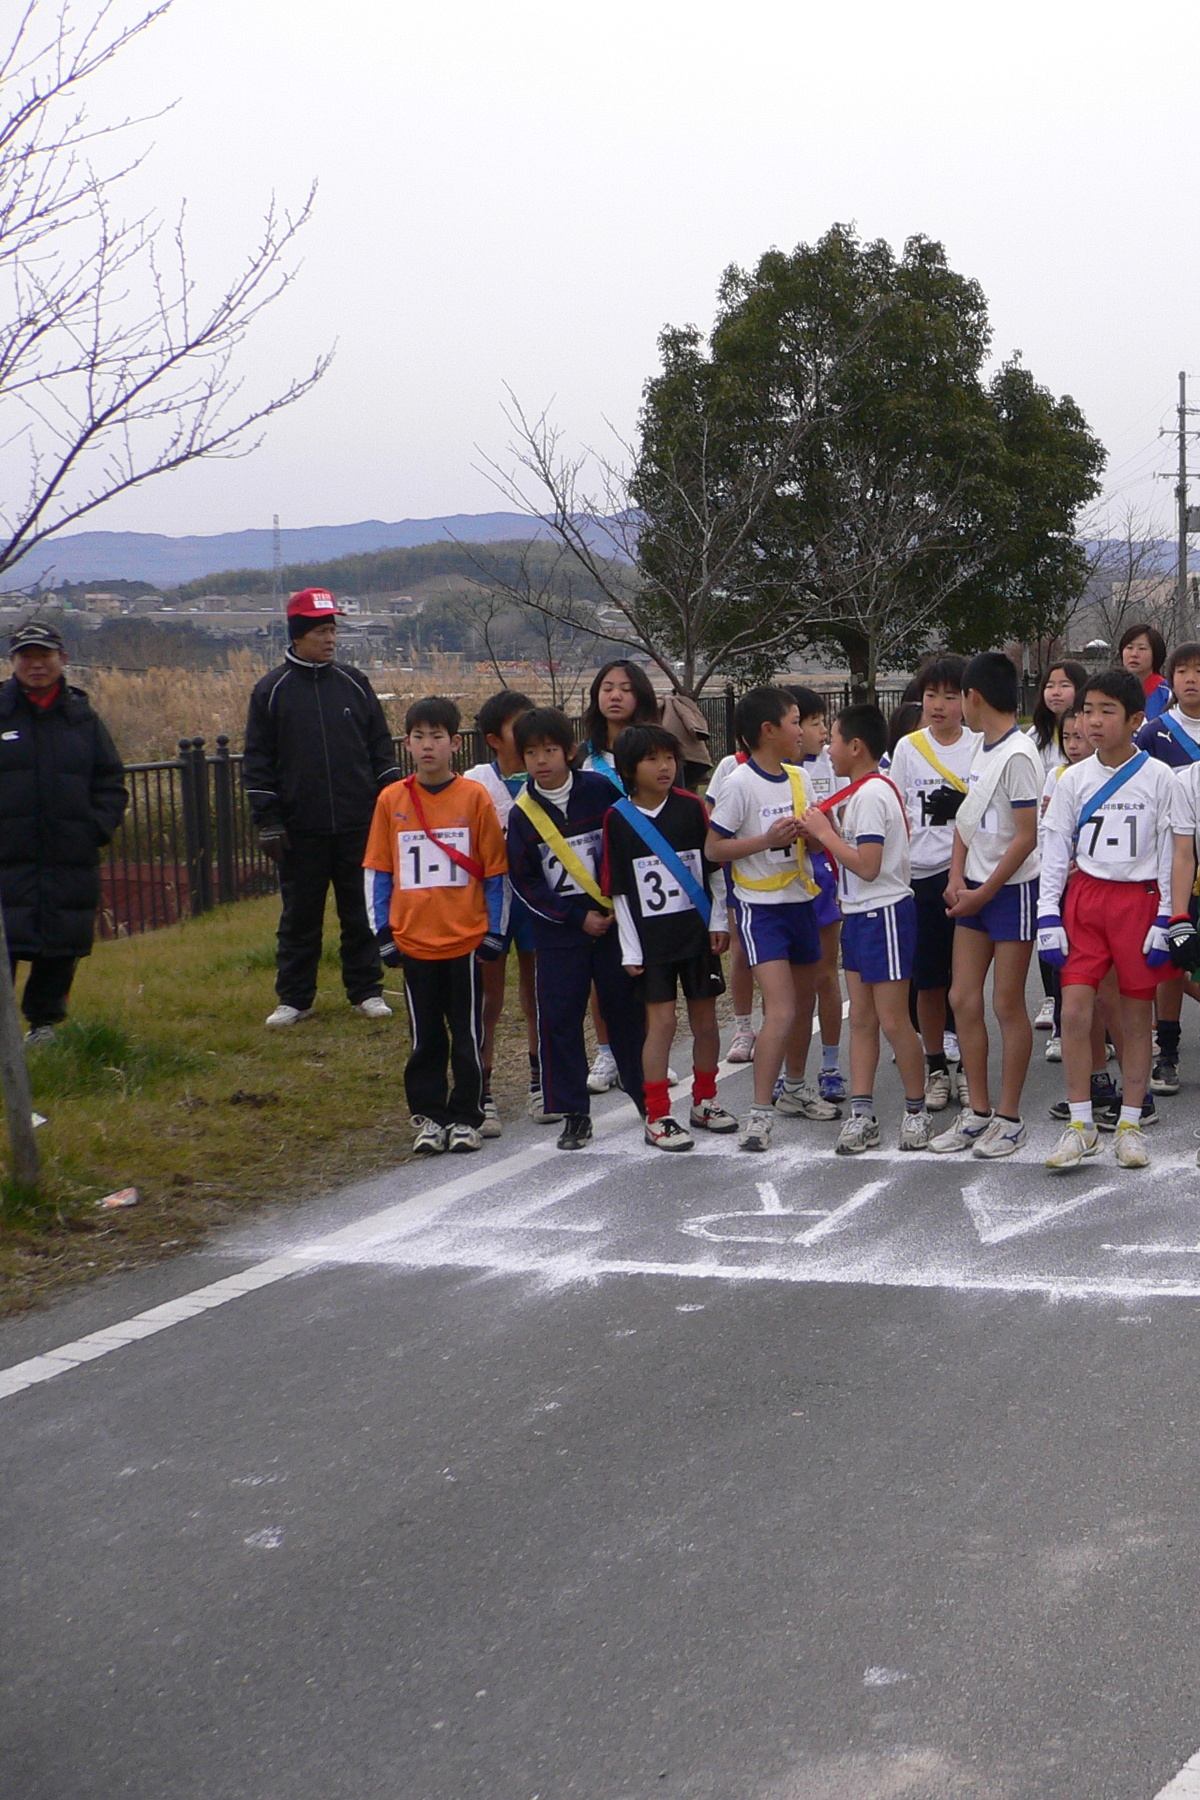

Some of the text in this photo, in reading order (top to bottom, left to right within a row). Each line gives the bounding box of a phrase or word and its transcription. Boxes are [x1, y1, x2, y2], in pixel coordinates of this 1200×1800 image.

[1085, 815, 1137, 858] 7-1
[408, 843, 457, 885] 1-1
[548, 847, 601, 893] 21
[644, 866, 695, 912] 3-
